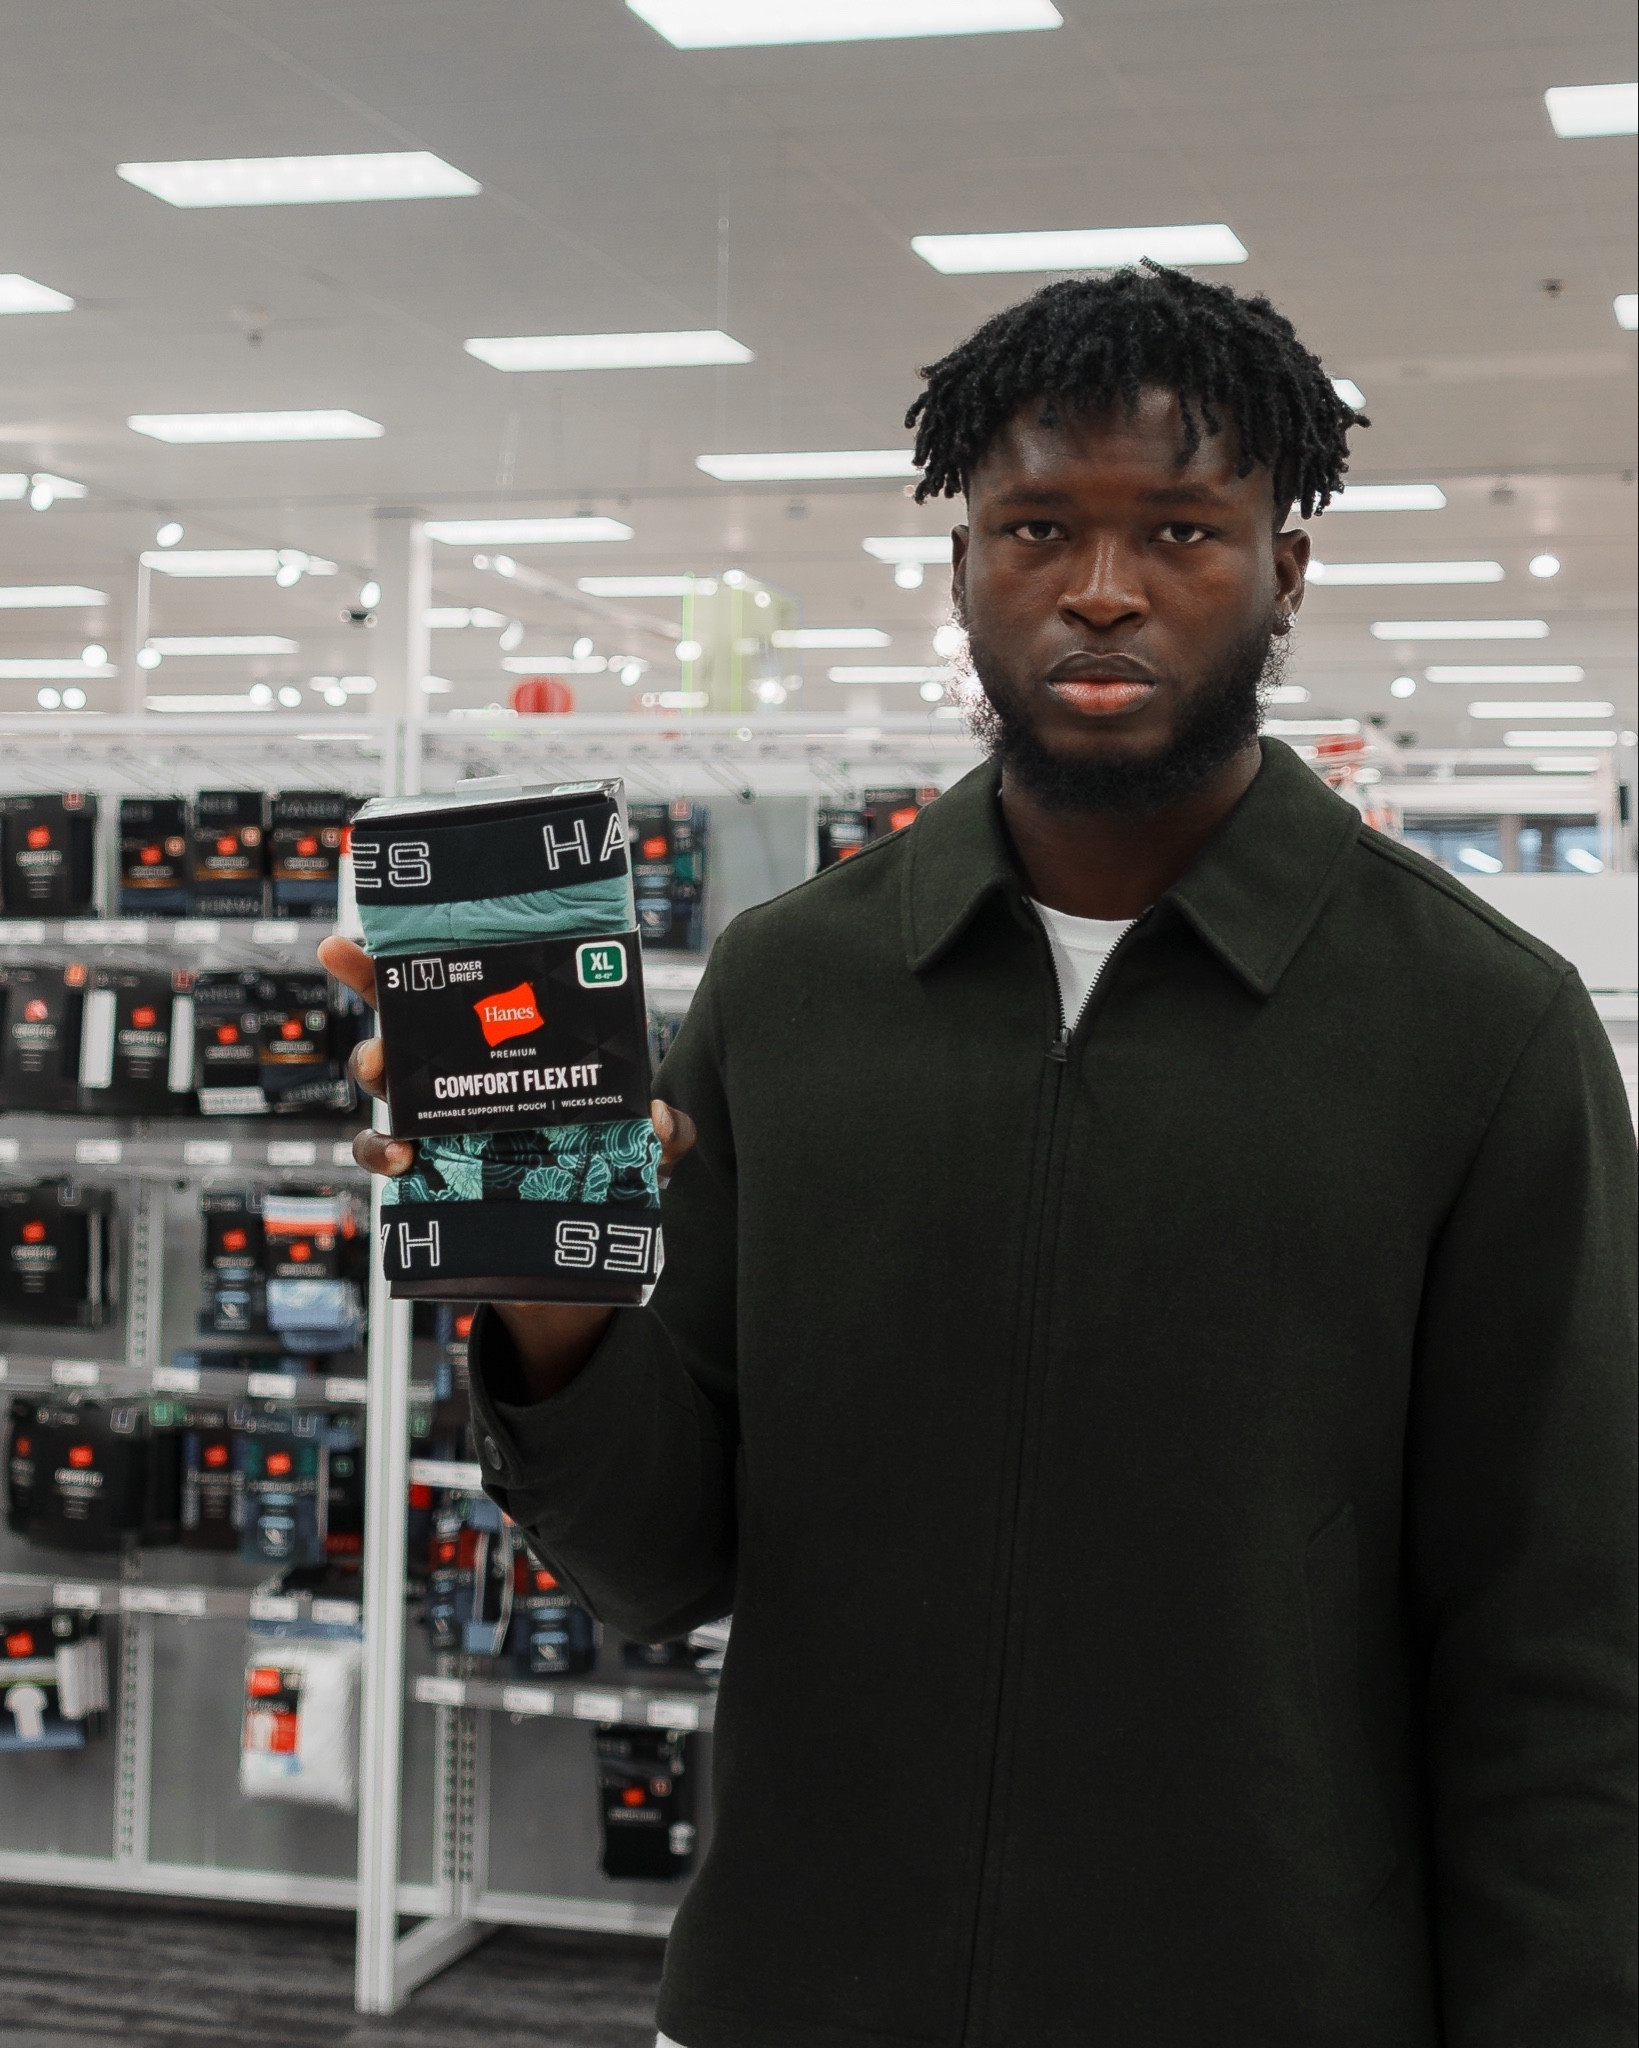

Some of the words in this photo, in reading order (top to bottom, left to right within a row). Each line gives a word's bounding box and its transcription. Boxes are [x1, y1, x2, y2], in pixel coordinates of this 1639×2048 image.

[448, 960, 482, 973] BOXER
[590, 951, 615, 971] XL
[386, 967, 400, 989] 3
[449, 971, 484, 983] BRIEFS
[484, 1005, 535, 1023] Hanes
[490, 1047, 537, 1059] PREMIUM
[434, 1071, 519, 1099] COMFORT
[523, 1066, 569, 1092] FLEX
[570, 1063, 600, 1088] FIT
[418, 1108, 466, 1120] BREATHABLE
[467, 1104, 515, 1116] SUPPORTIVE
[517, 1102, 547, 1112] POUCH
[561, 1098, 586, 1108] WICKS
[587, 1097, 594, 1106] &
[594, 1095, 623, 1105] COOLS
